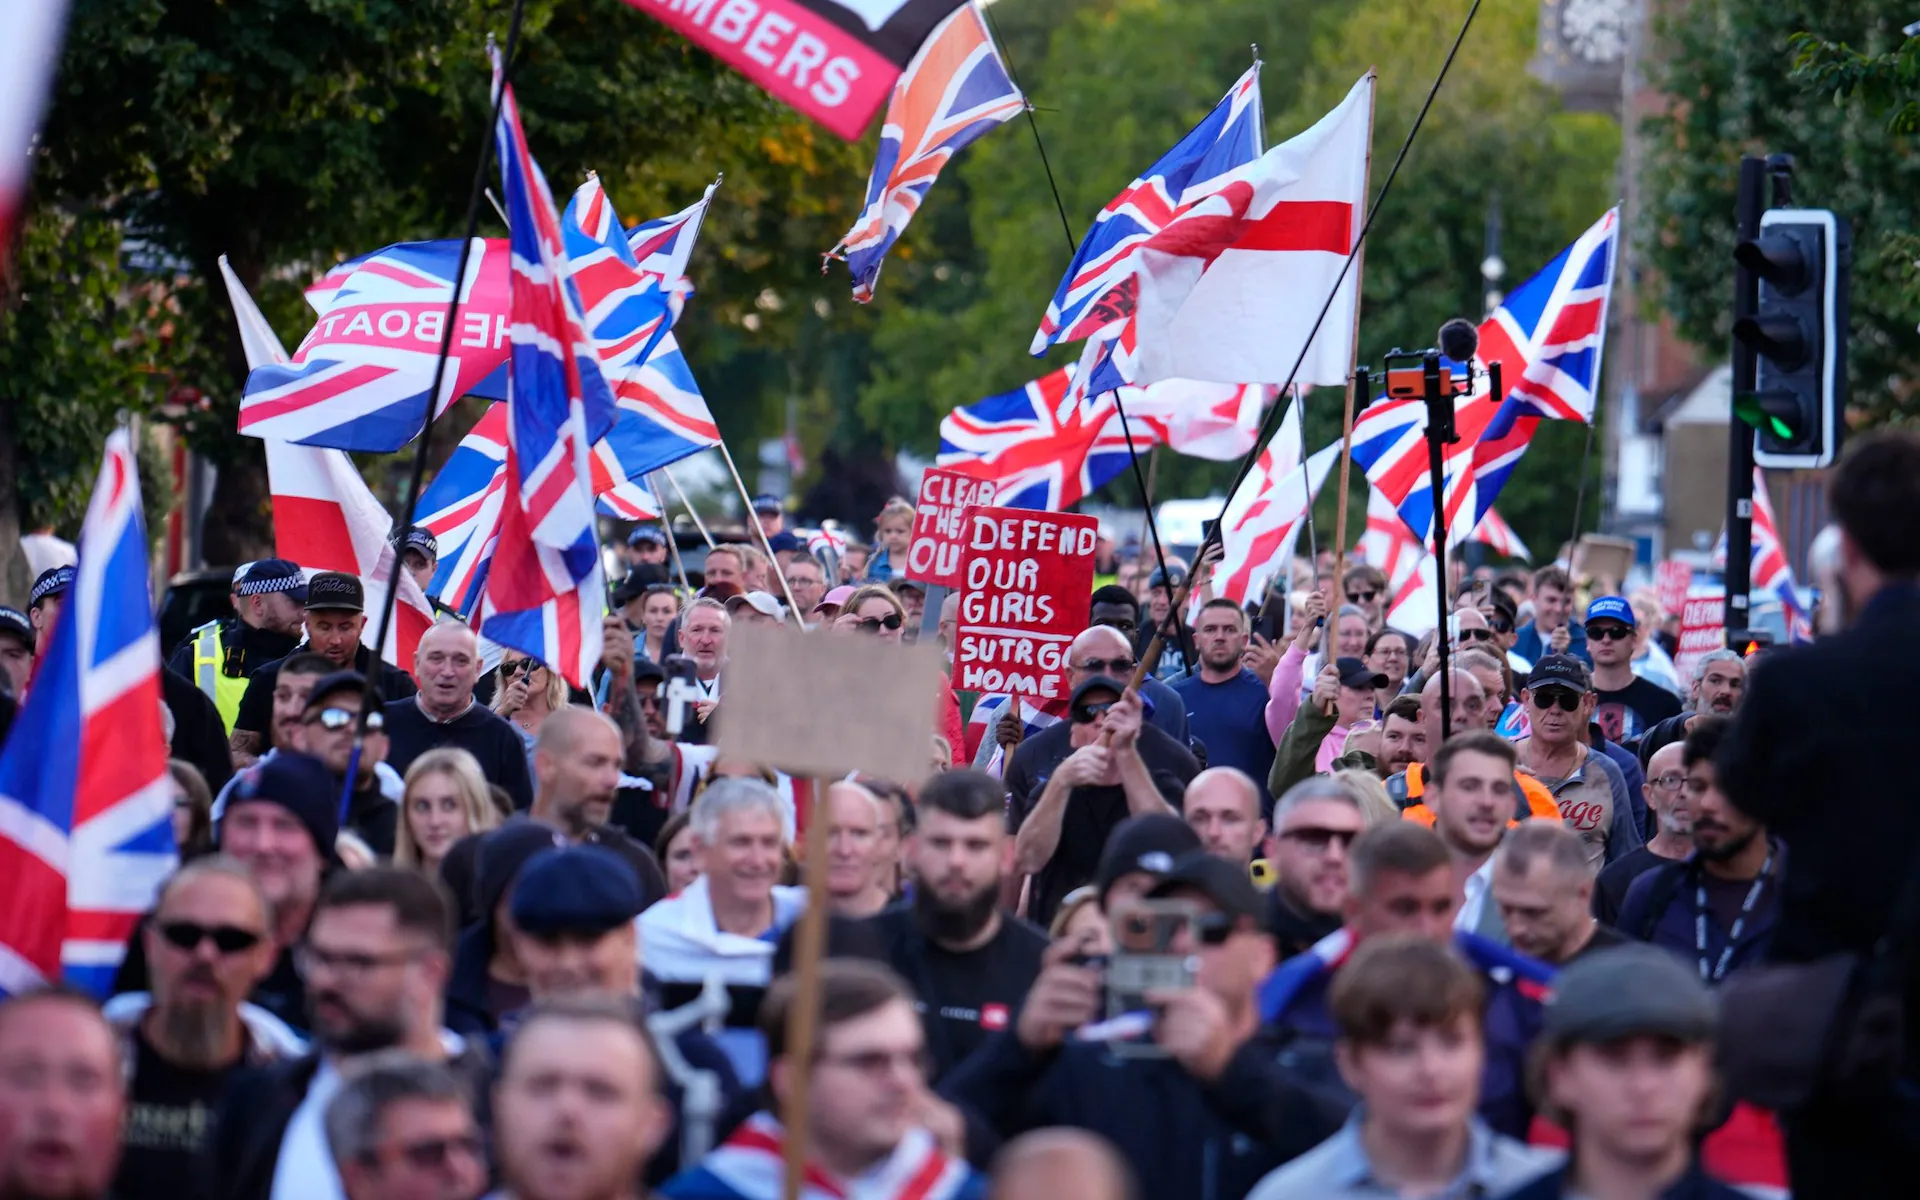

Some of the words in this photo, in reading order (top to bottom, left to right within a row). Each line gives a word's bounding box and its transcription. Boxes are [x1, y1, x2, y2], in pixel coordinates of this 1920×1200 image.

[655, 0, 862, 107] MBERS
[922, 474, 997, 508] CLEAR
[917, 504, 968, 541] THE
[970, 515, 1096, 557] DEFEND
[908, 536, 966, 577] OU
[967, 557, 1040, 592] OUR
[962, 590, 1055, 625] GIRLS
[959, 636, 1034, 666] SUTR
[962, 664, 1061, 699] HOME
